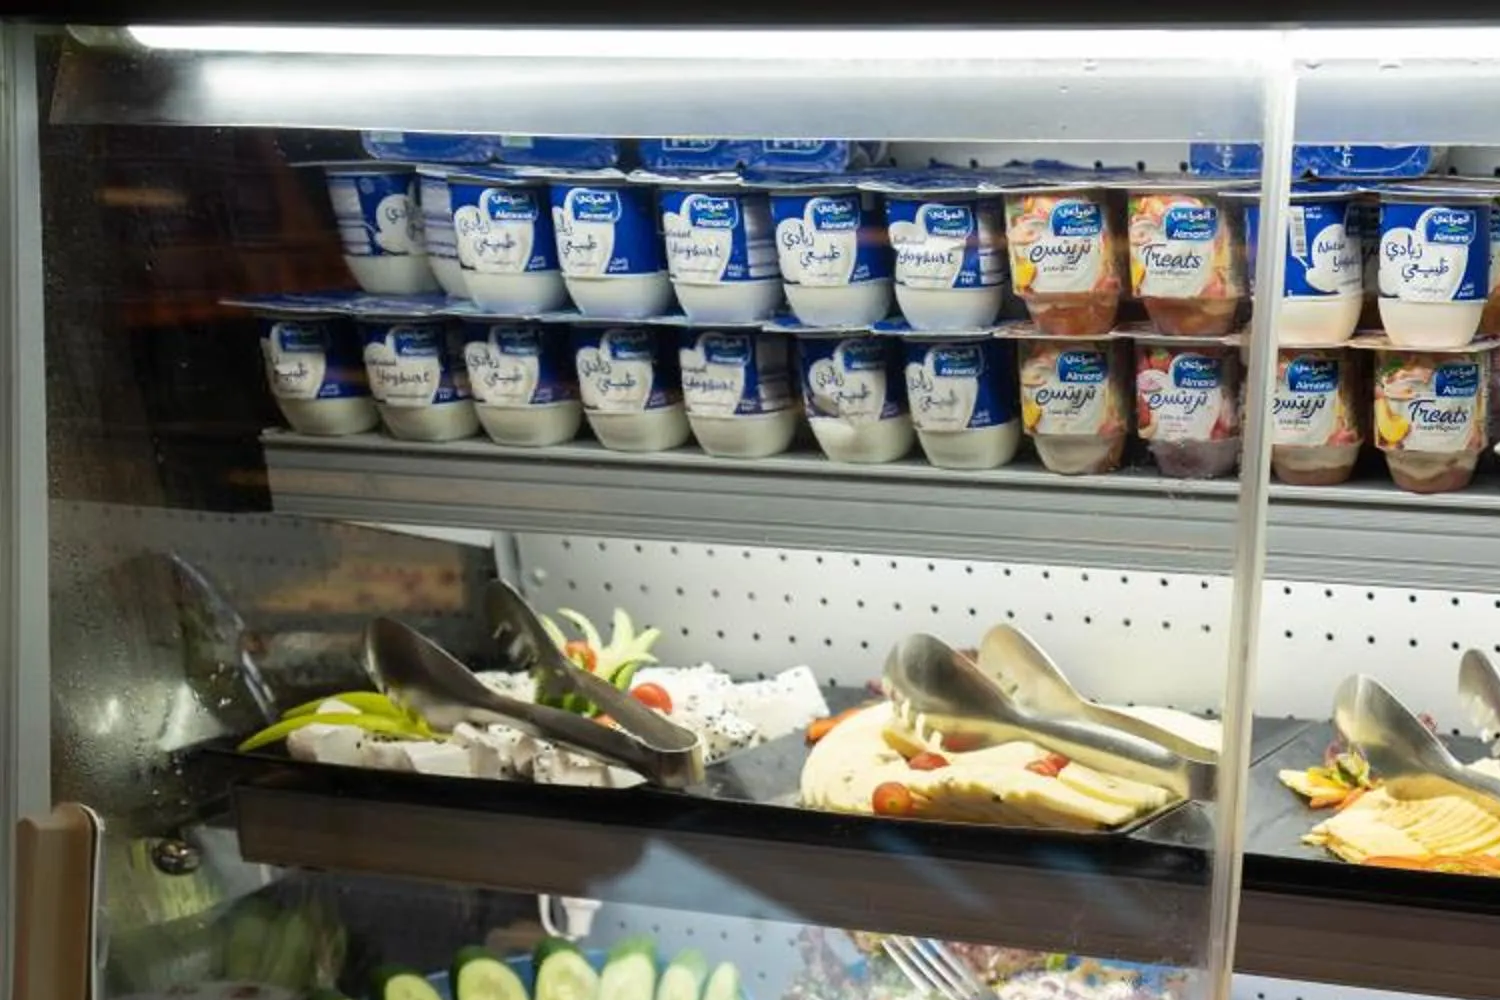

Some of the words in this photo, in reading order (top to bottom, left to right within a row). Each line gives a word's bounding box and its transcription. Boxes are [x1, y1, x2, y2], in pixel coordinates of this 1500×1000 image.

[782, 224, 815, 250] زبادي
[1385, 233, 1423, 261] زبادي
[800, 242, 841, 270] طبيعي
[898, 248, 955, 267] Yoghurt
[1141, 243, 1203, 268] Treats
[1401, 256, 1450, 282] طبيعي
[597, 370, 637, 396] طبيعي
[1035, 385, 1097, 409] تريتس
[1149, 390, 1209, 415] تريتس
[1407, 399, 1469, 424] Treats
